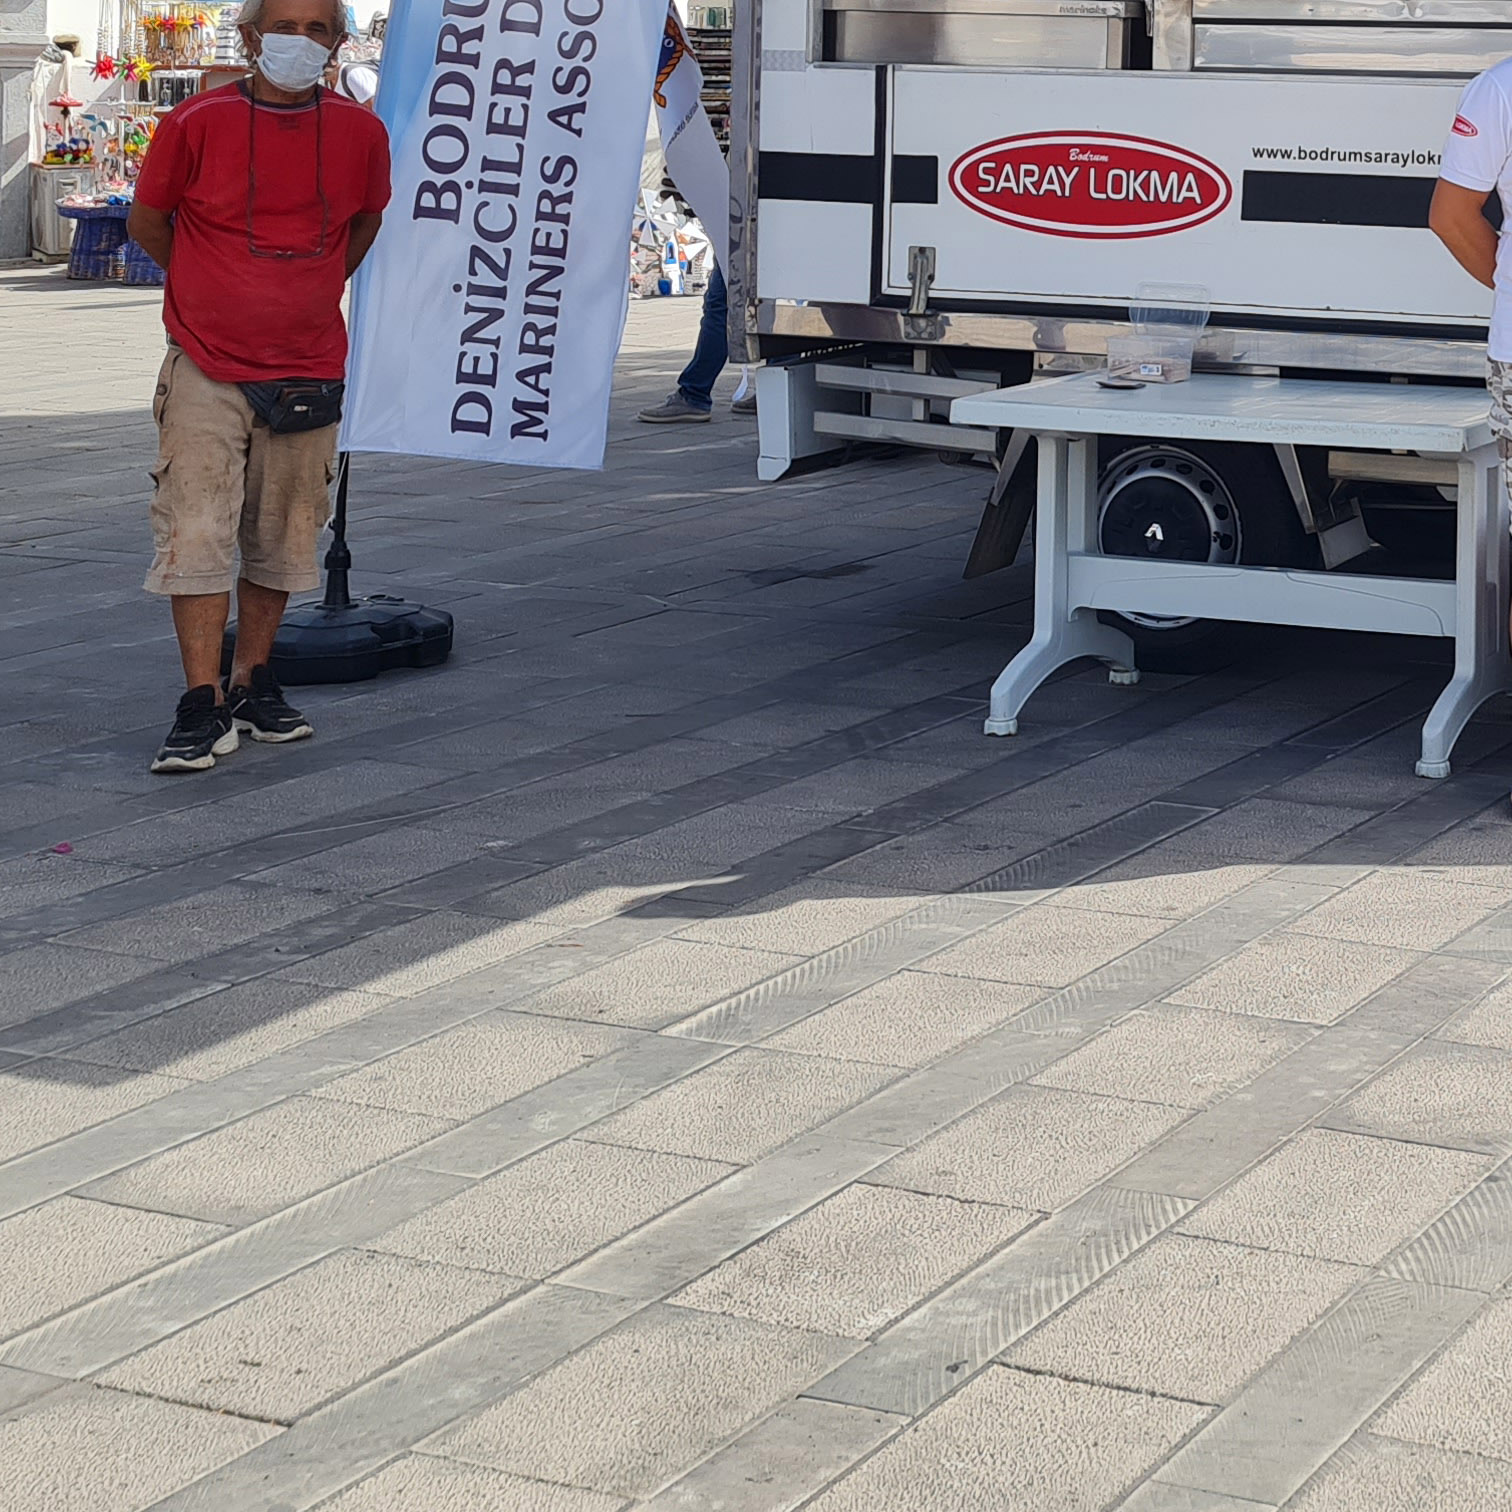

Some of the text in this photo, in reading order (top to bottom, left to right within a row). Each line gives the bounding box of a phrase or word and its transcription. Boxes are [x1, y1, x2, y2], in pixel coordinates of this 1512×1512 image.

[977, 162, 1202, 205] SARAY LOKMA
[1068, 148, 1109, 163] Bodrum
[450, 57, 536, 439] DENİZCİLER
[510, 155, 578, 442] MARINERS
